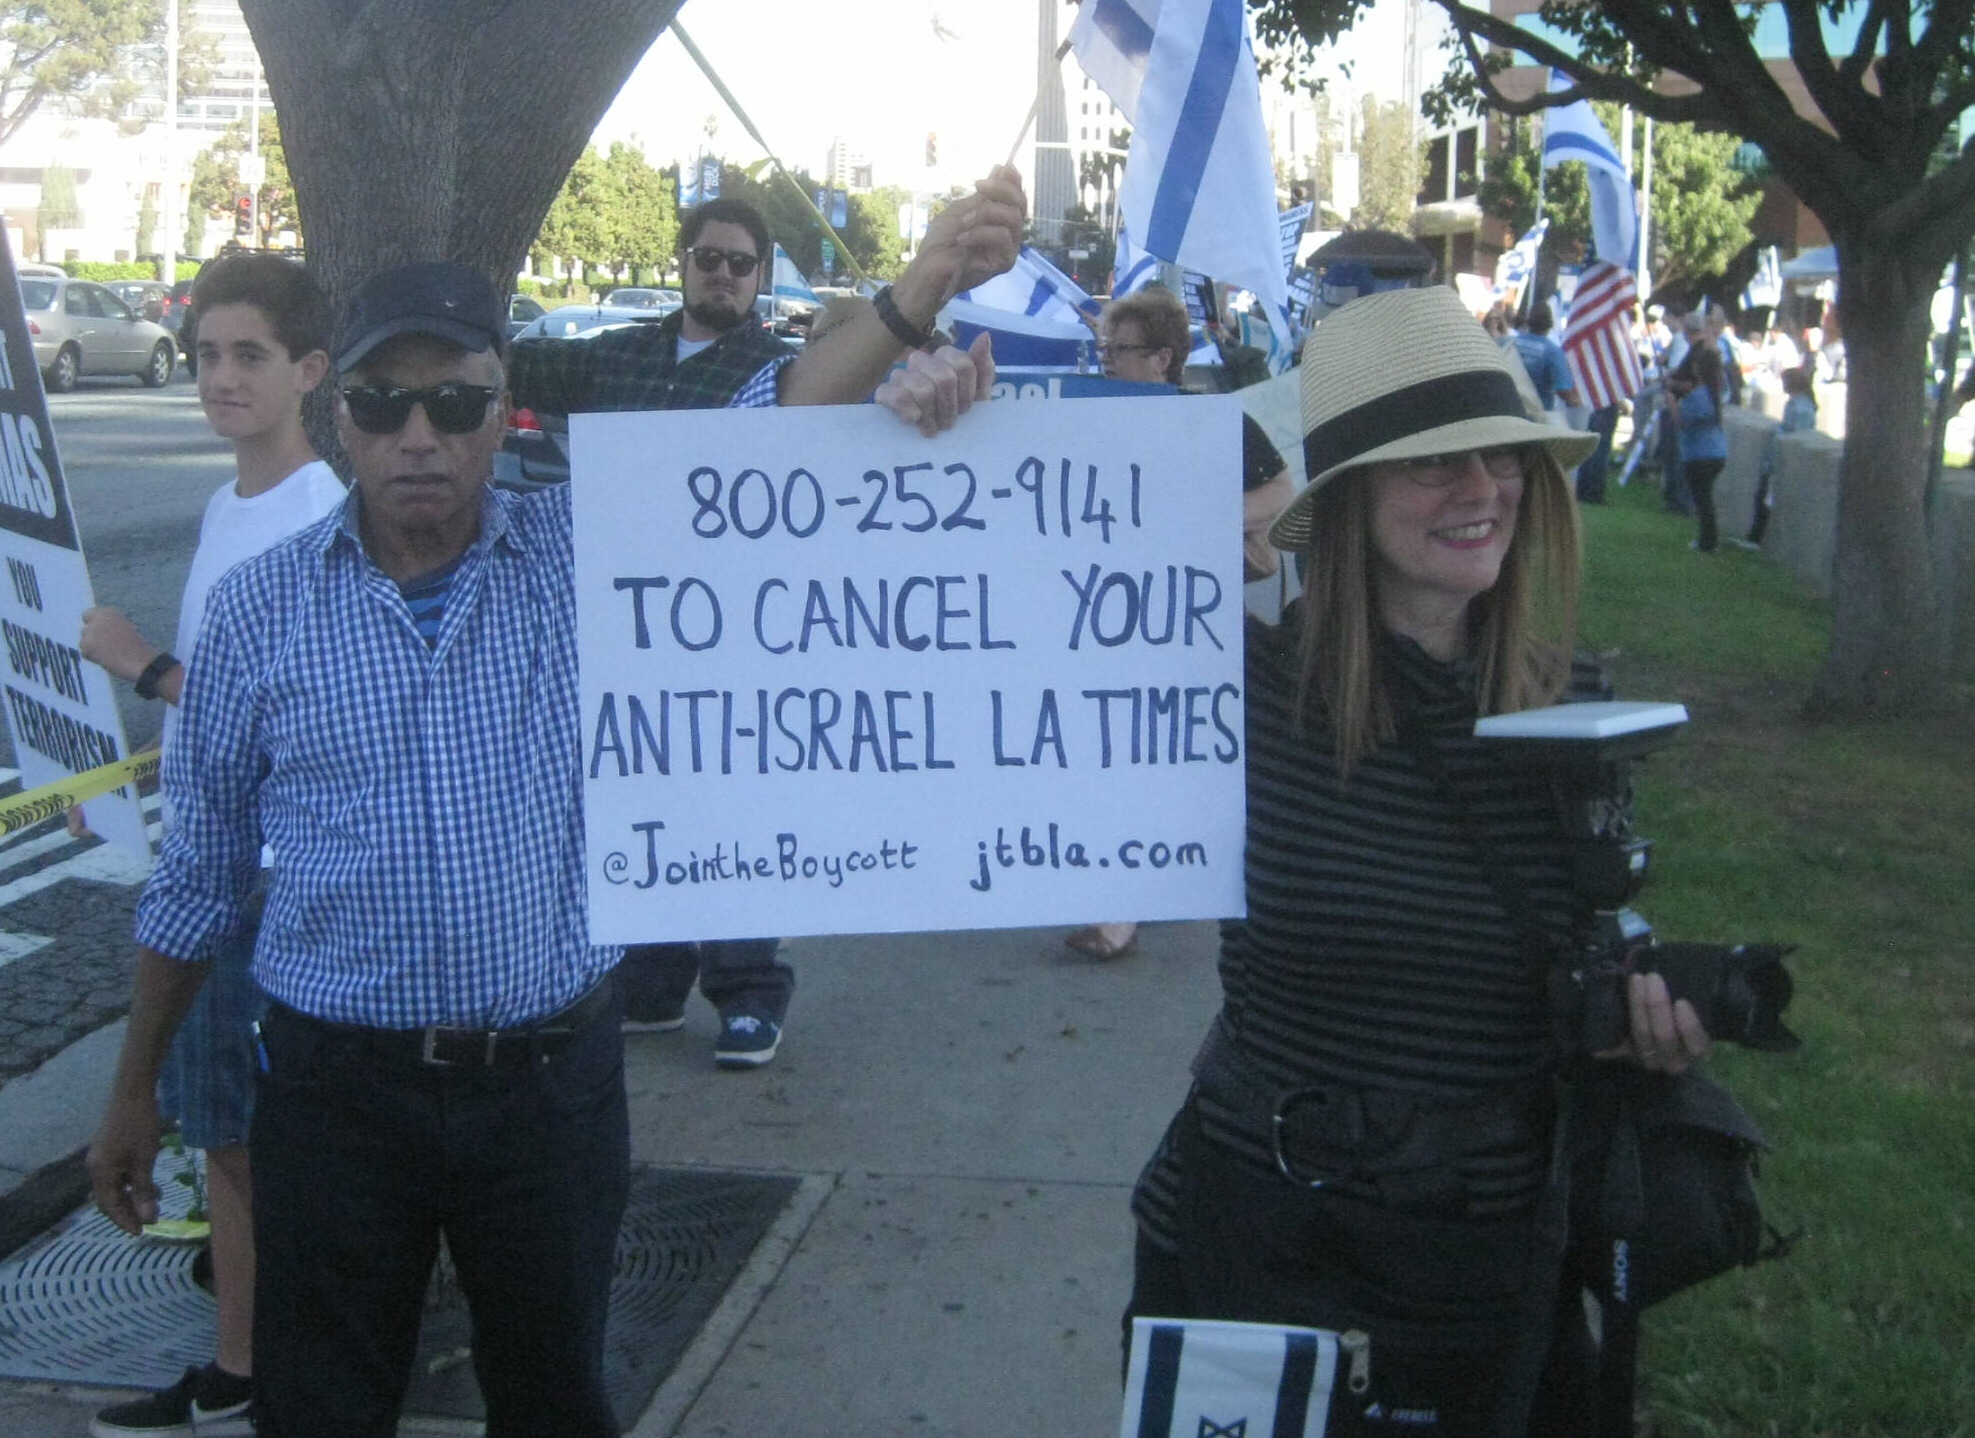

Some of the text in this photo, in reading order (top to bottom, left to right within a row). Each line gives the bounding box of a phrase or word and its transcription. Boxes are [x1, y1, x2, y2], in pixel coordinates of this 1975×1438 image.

[687, 456, 1141, 544] 800-252-9141
[7, 556, 43, 612] YOU
[613, 563, 1224, 655] TO CANCEL YOUR
[2, 618, 88, 706] SUPPORT
[590, 683, 1240, 778] ANTI-ISRAEL LA TIMES
[603, 821, 1207, 892] @JointheBoycott jtbla.com
[1613, 1239, 1628, 1301] SONY
